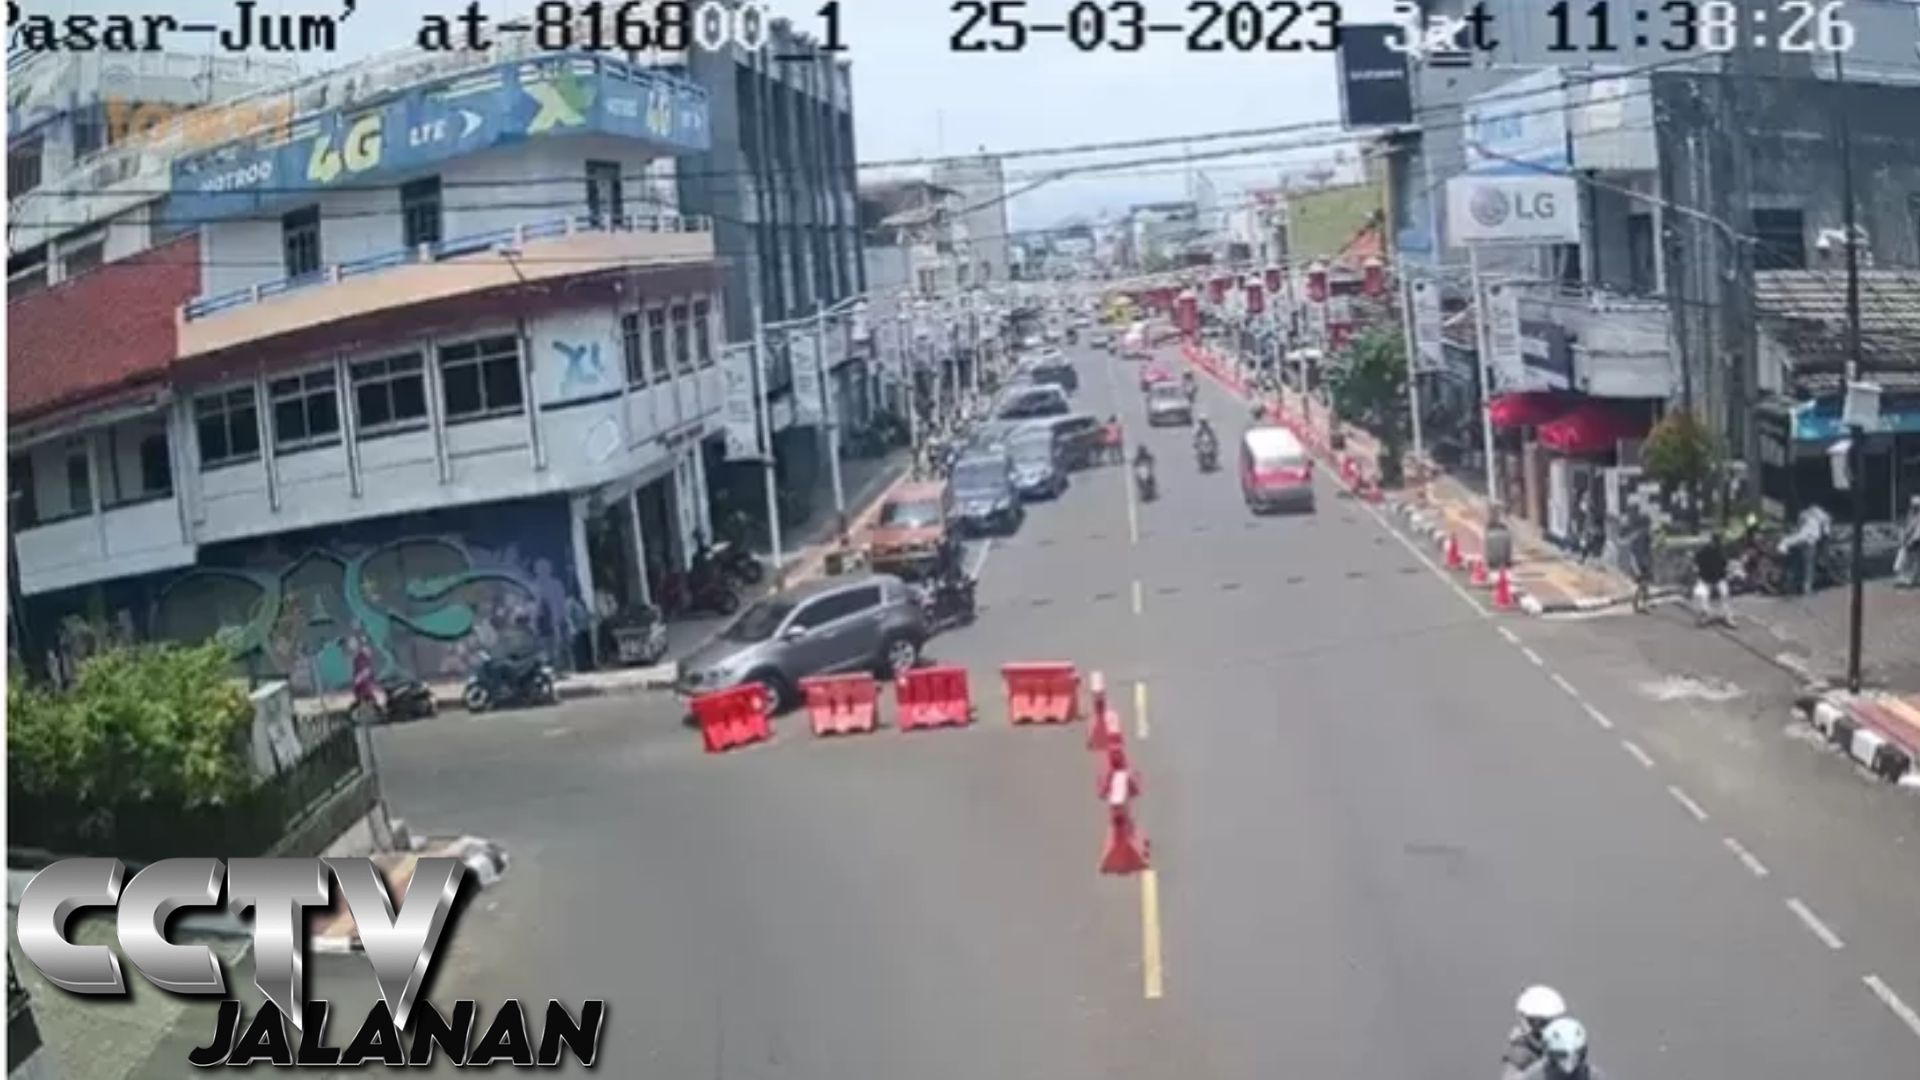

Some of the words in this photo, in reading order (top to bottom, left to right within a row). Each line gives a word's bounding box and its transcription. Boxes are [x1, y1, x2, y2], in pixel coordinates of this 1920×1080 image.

[307, 112, 384, 183] 4G
[409, 119, 448, 147] LTE
[1515, 192, 1555, 219] LG
